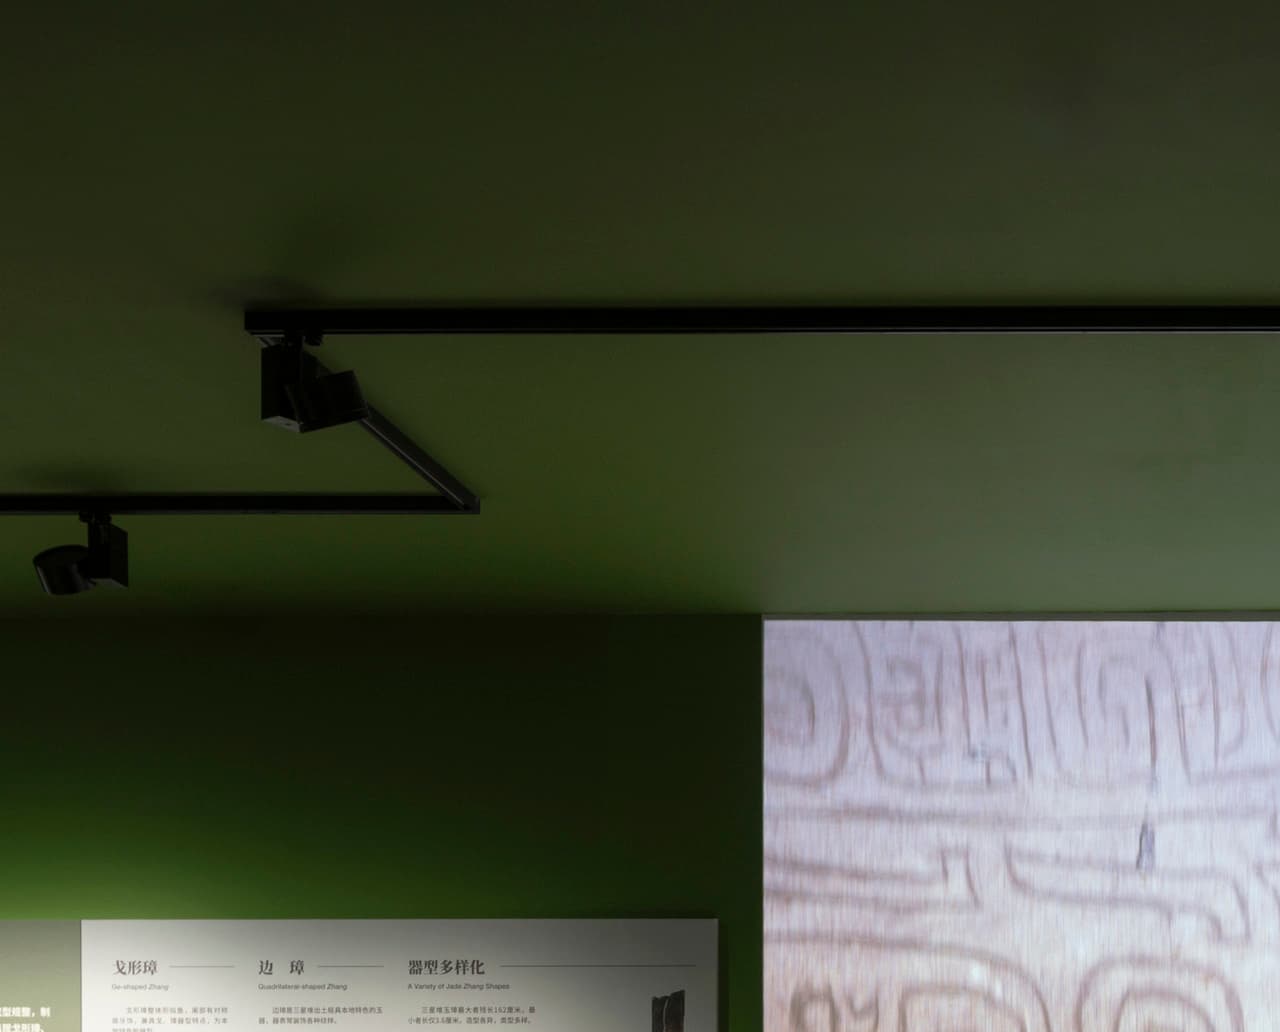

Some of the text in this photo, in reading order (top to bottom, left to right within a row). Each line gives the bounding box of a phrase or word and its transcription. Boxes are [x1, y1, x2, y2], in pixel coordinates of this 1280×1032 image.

[112, 960, 158, 975] 戈形璋
[258, 960, 304, 975] 边璋
[408, 960, 486, 975] 器型多样化
